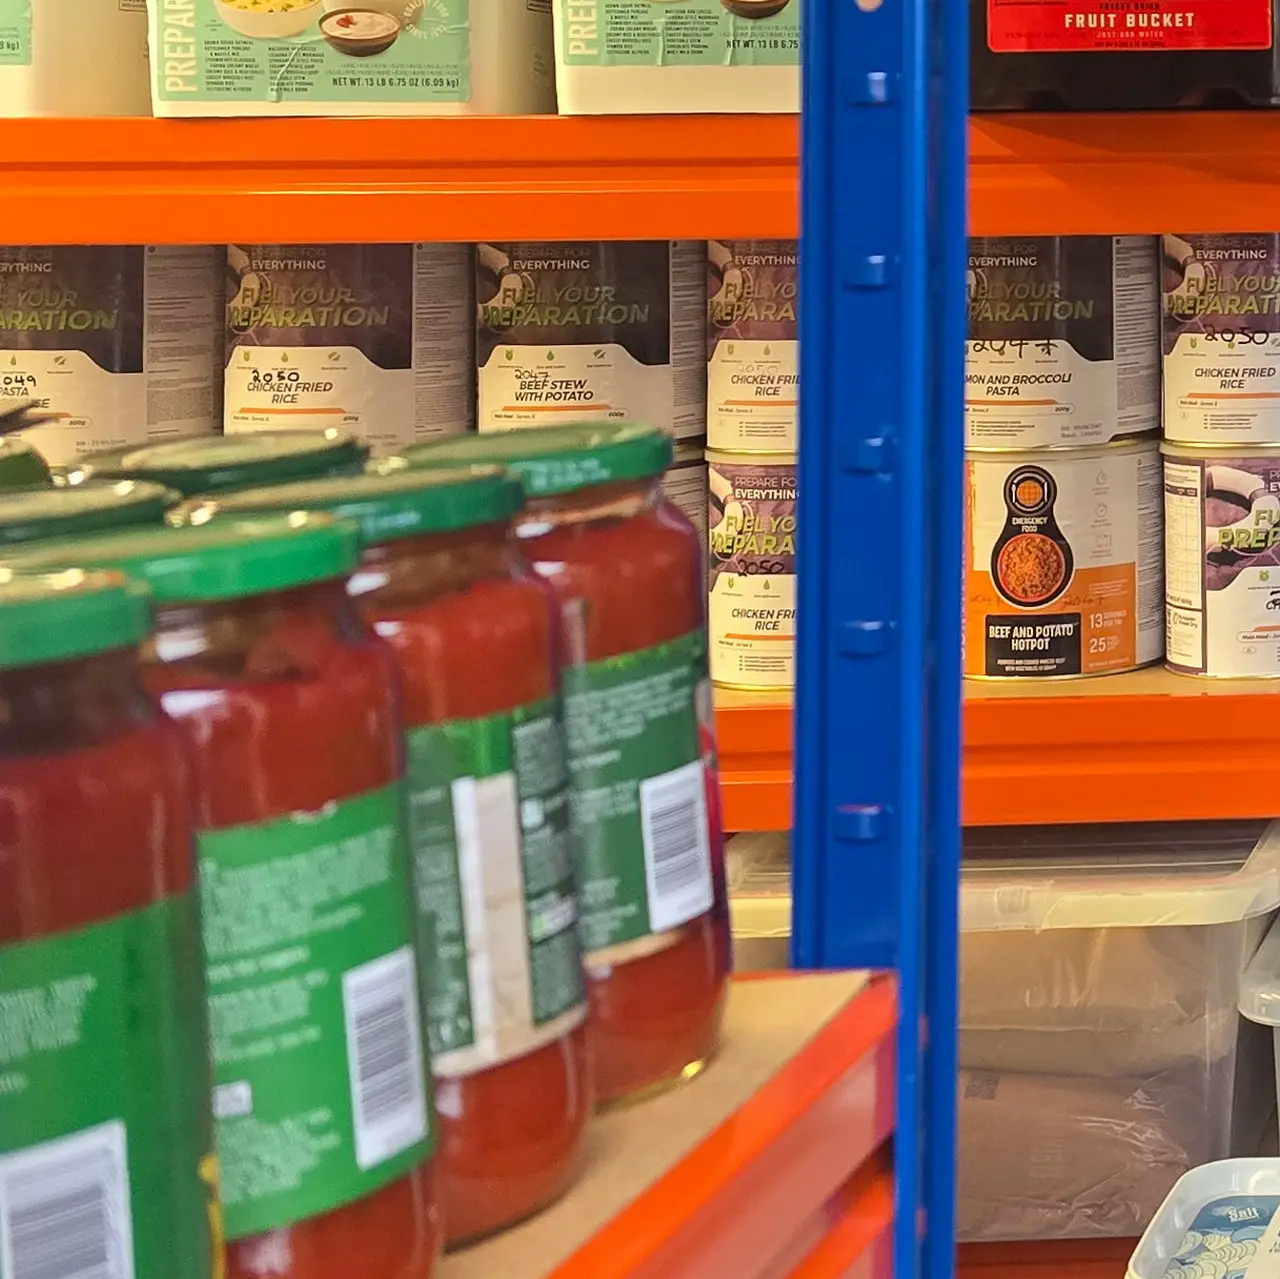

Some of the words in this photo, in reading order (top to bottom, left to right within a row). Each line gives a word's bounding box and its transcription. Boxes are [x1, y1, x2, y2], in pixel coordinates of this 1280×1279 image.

[1065, 13, 1116, 29] FRUIT
[1126, 12, 1195, 28] BUCKET
[332, 77, 347, 87] NET
[388, 77, 407, 88] 6.75
[251, 259, 326, 270] EVERYTHING
[1204, 325, 1268, 344] 2050
[252, 370, 300, 383] 2050
[1195, 368, 1238, 378] CHICKEN
[1241, 367, 1276, 378] FRIED
[991, 374, 1011, 384] AND
[1013, 373, 1071, 383] BROCCOLI
[247, 381, 292, 393] CHICKEN
[295, 381, 333, 393] FRIED
[519, 380, 549, 390] BEEF
[550, 379, 587, 390] STEW
[545, 391, 594, 401] POTATO
[986, 387, 1019, 396] PASTA
[272, 393, 298, 404] RICE
[731, 608, 774, 620] CHICKEN
[755, 620, 779, 630] RICE
[1089, 613, 1103, 629] 13
[989, 626, 1010, 638] BEEF
[1013, 626, 1033, 638] AND
[1036, 624, 1073, 636] POTATO
[1011, 638, 1050, 651] HOTPOT
[1089, 638, 1106, 653] 25
